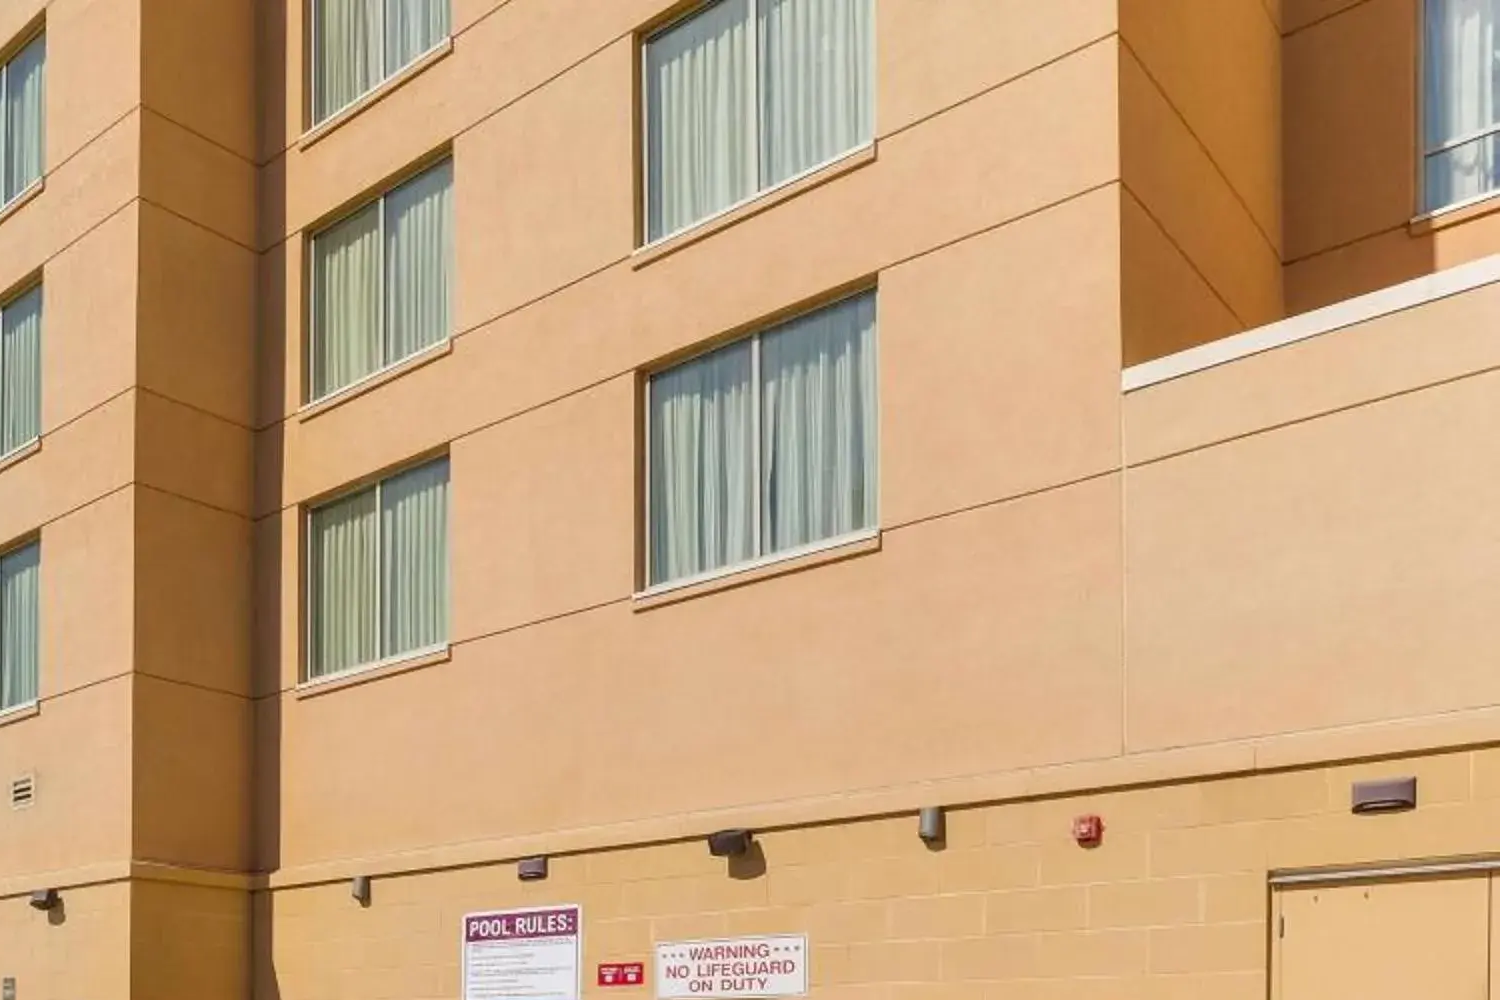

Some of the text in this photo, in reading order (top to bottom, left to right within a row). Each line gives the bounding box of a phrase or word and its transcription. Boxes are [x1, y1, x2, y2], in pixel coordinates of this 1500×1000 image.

[469, 914, 573, 937] POOL RULES:
[689, 943, 770, 961] WARNING
[666, 959, 796, 979] NO LIFEGUARD
[689, 978, 768, 993] ON DUTY
